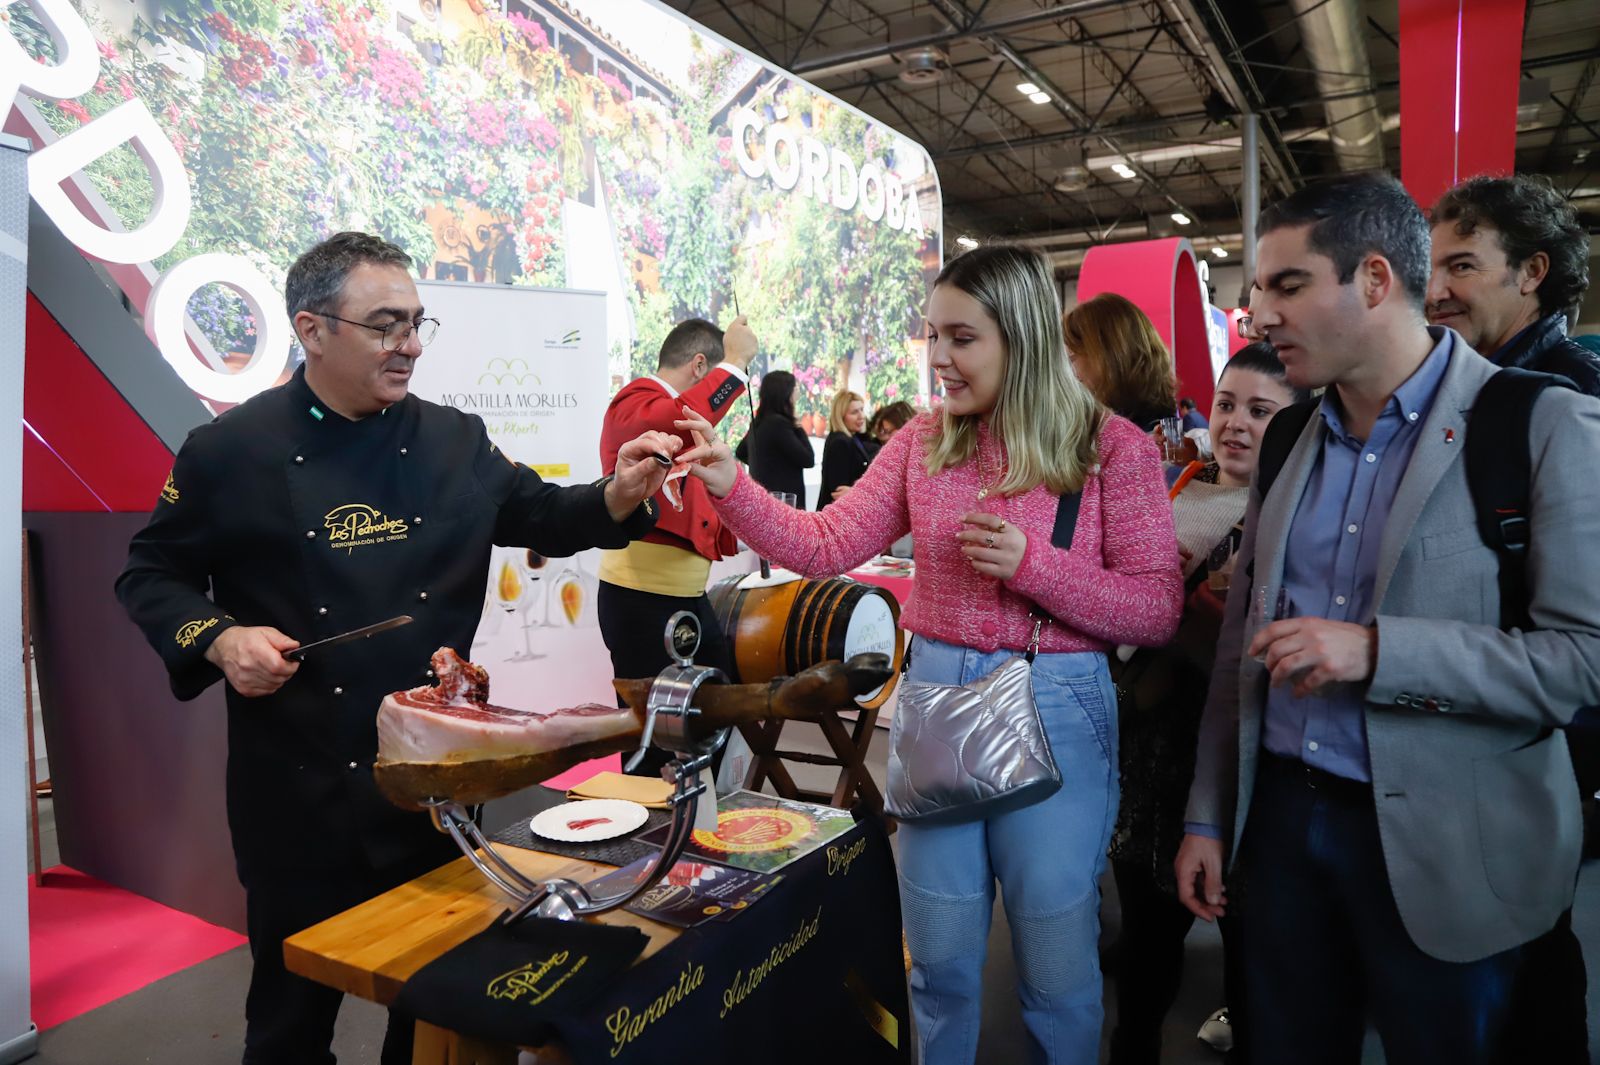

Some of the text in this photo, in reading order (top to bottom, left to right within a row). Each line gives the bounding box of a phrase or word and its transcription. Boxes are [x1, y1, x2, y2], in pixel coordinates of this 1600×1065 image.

[732, 104, 925, 240] CÓRDOBA
[440, 393, 578, 409] MONTILLA MORILES
[328, 511, 408, 549] Los Pedroches
[331, 538, 375, 549] DENOMINACIÓN
[386, 533, 408, 542] ORIGEN
[826, 836, 867, 877] Origen
[719, 905, 823, 1019] Autenticidad
